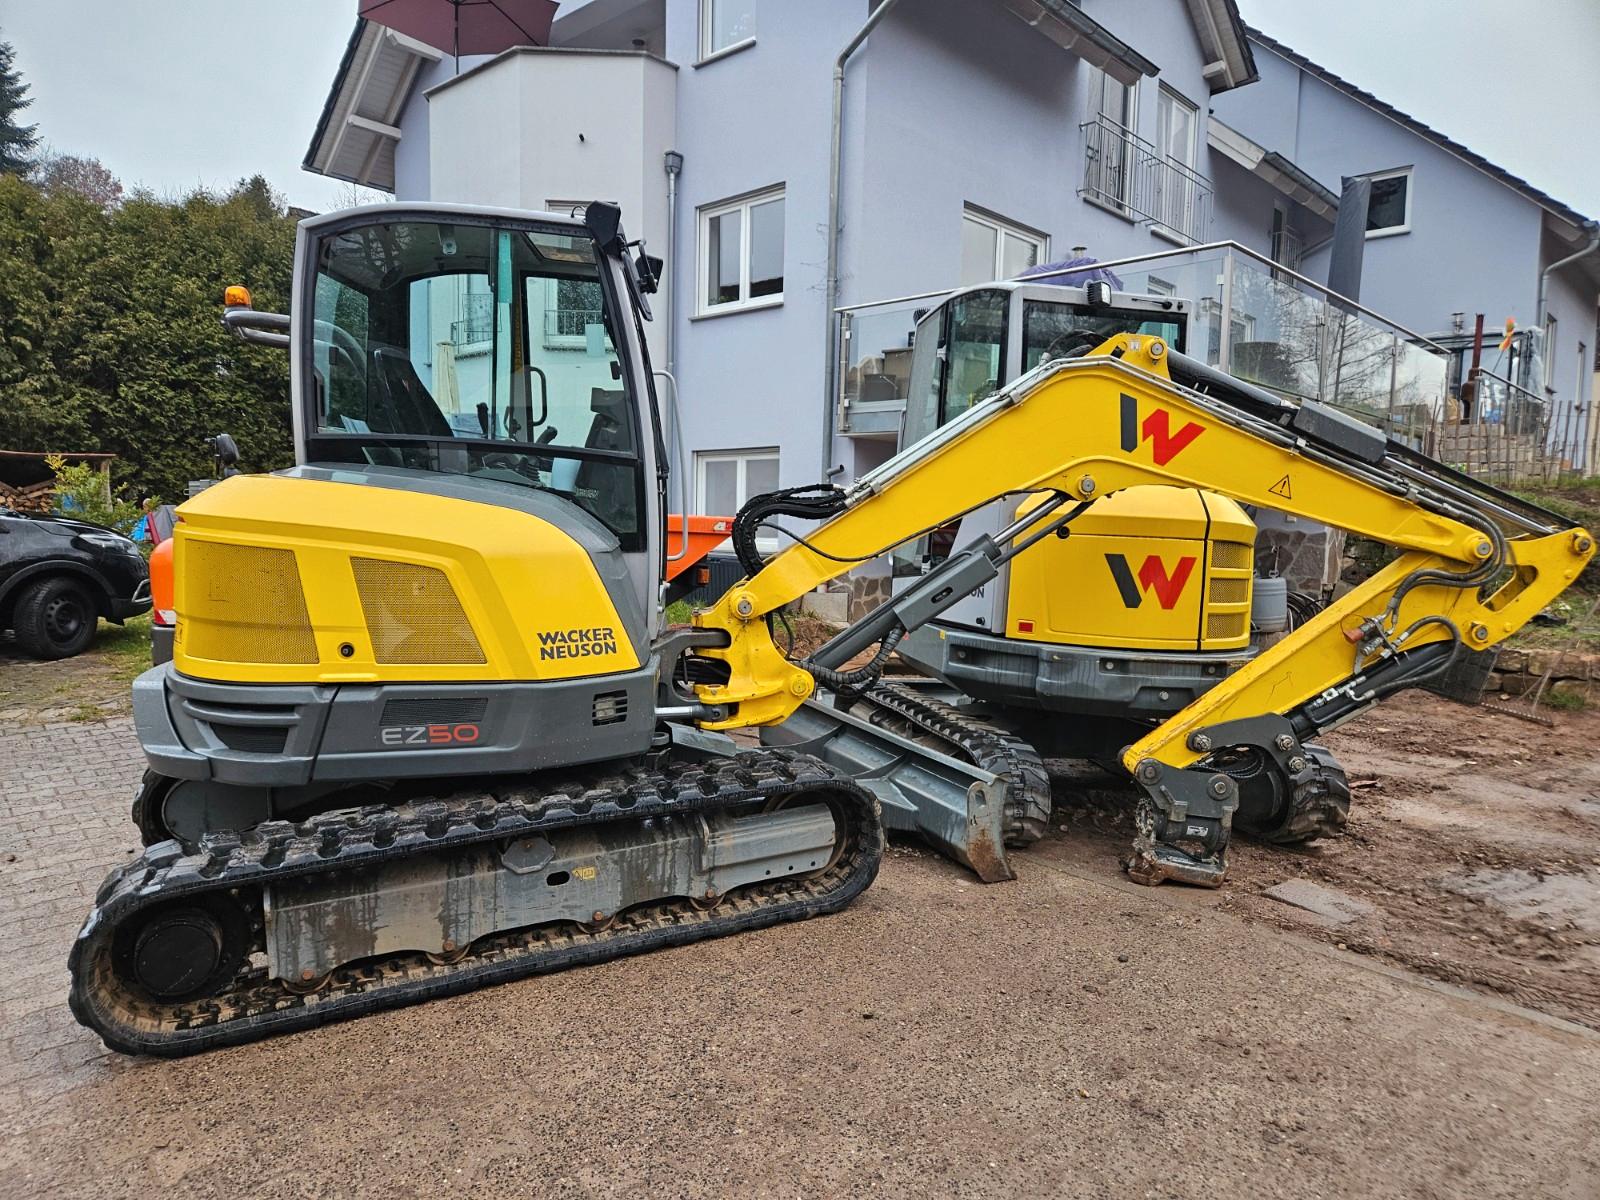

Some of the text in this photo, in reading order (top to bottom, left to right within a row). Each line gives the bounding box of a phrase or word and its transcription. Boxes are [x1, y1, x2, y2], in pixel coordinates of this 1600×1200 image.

[537, 627, 615, 646] WACKER
[540, 641, 617, 661] NEUSON
[381, 724, 479, 745] EZ50
